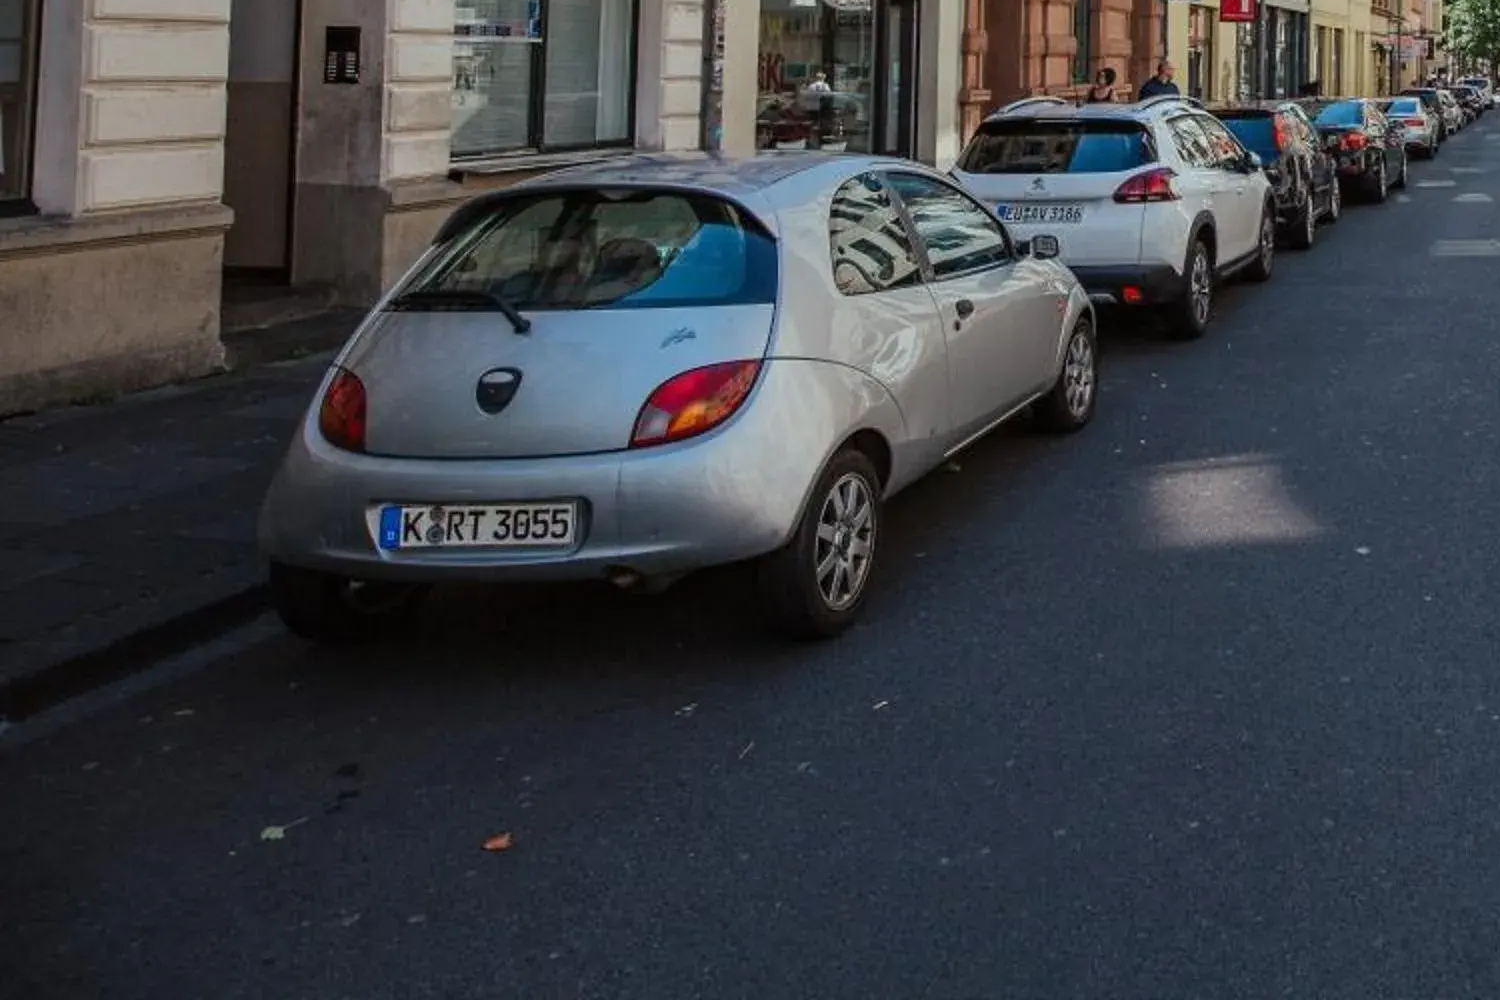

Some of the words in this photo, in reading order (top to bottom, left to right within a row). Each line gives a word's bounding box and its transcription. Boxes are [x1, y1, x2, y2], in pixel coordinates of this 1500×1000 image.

[403, 511, 424, 542] K
[446, 510, 486, 542] RT
[493, 509, 570, 541] 3055
